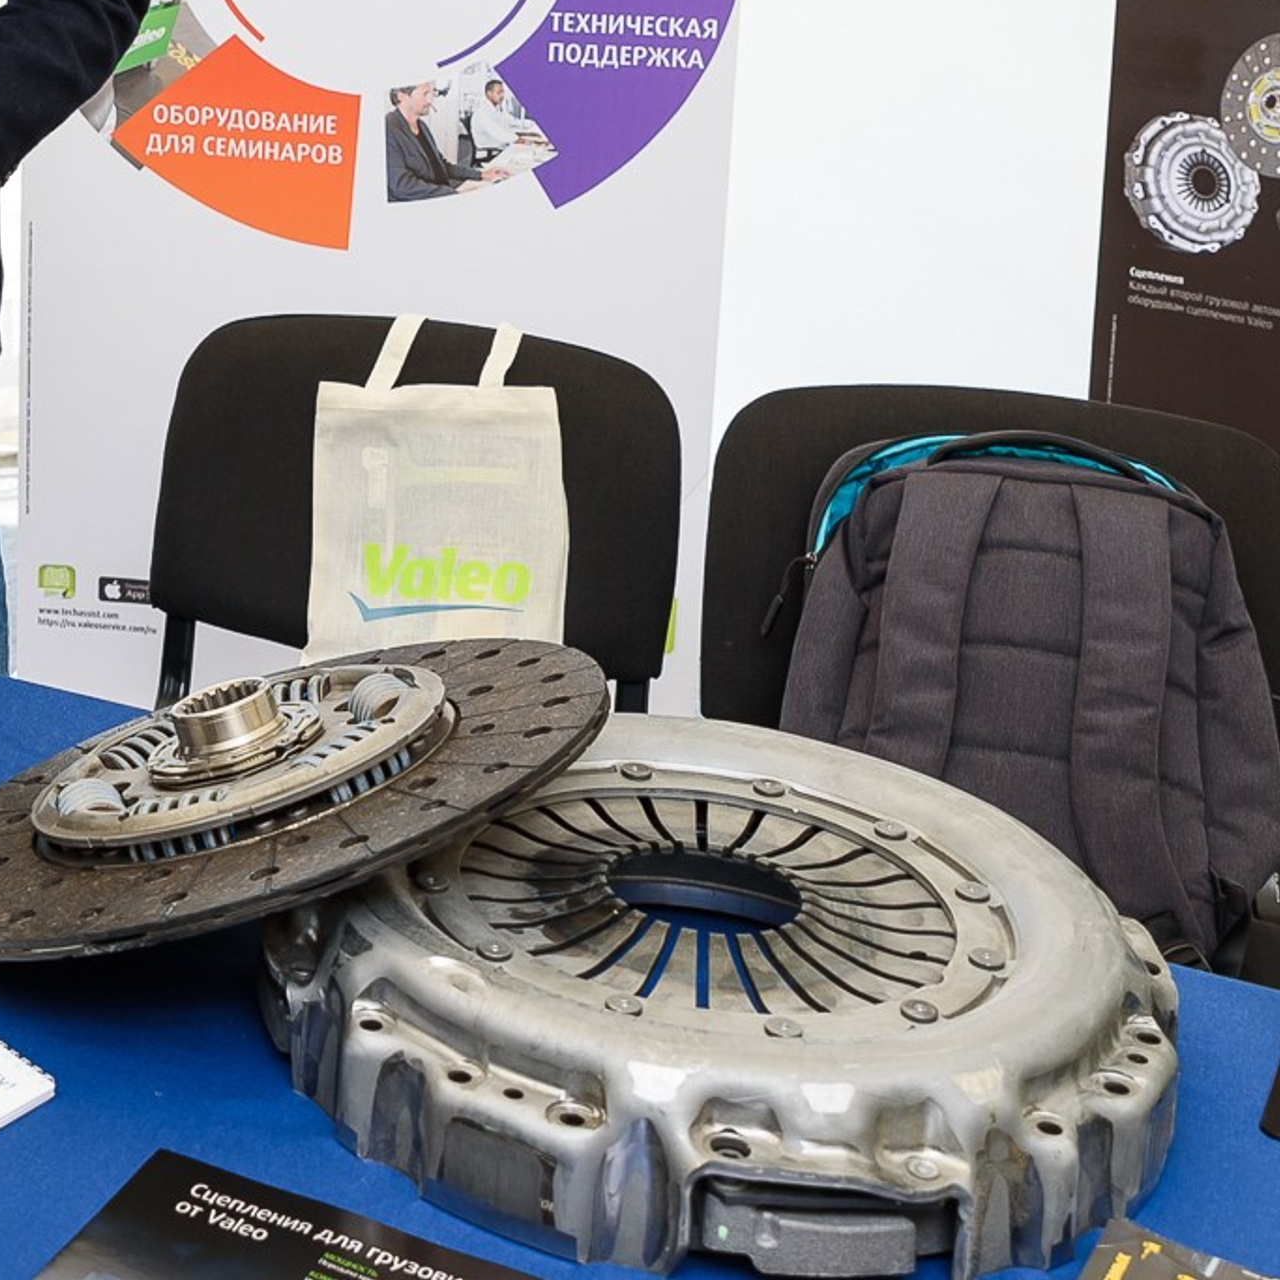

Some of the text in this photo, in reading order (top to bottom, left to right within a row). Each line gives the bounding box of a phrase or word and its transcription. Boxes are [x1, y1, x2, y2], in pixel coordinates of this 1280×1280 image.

[550, 11, 718, 40] ТЕХНИЧЕСКАЯ
[548, 42, 705, 70] ПОДДЕРЖКА
[153, 104, 337, 135] ОБОРУДОВАНИЕ
[145, 132, 343, 165] ДЛЯ СЕМИНАРОВ
[362, 543, 531, 604] Valeo
[175, 1200, 269, 1242] от Valeo
[189, 1183, 314, 1236] Сцепления
[312, 1228, 363, 1255] для
